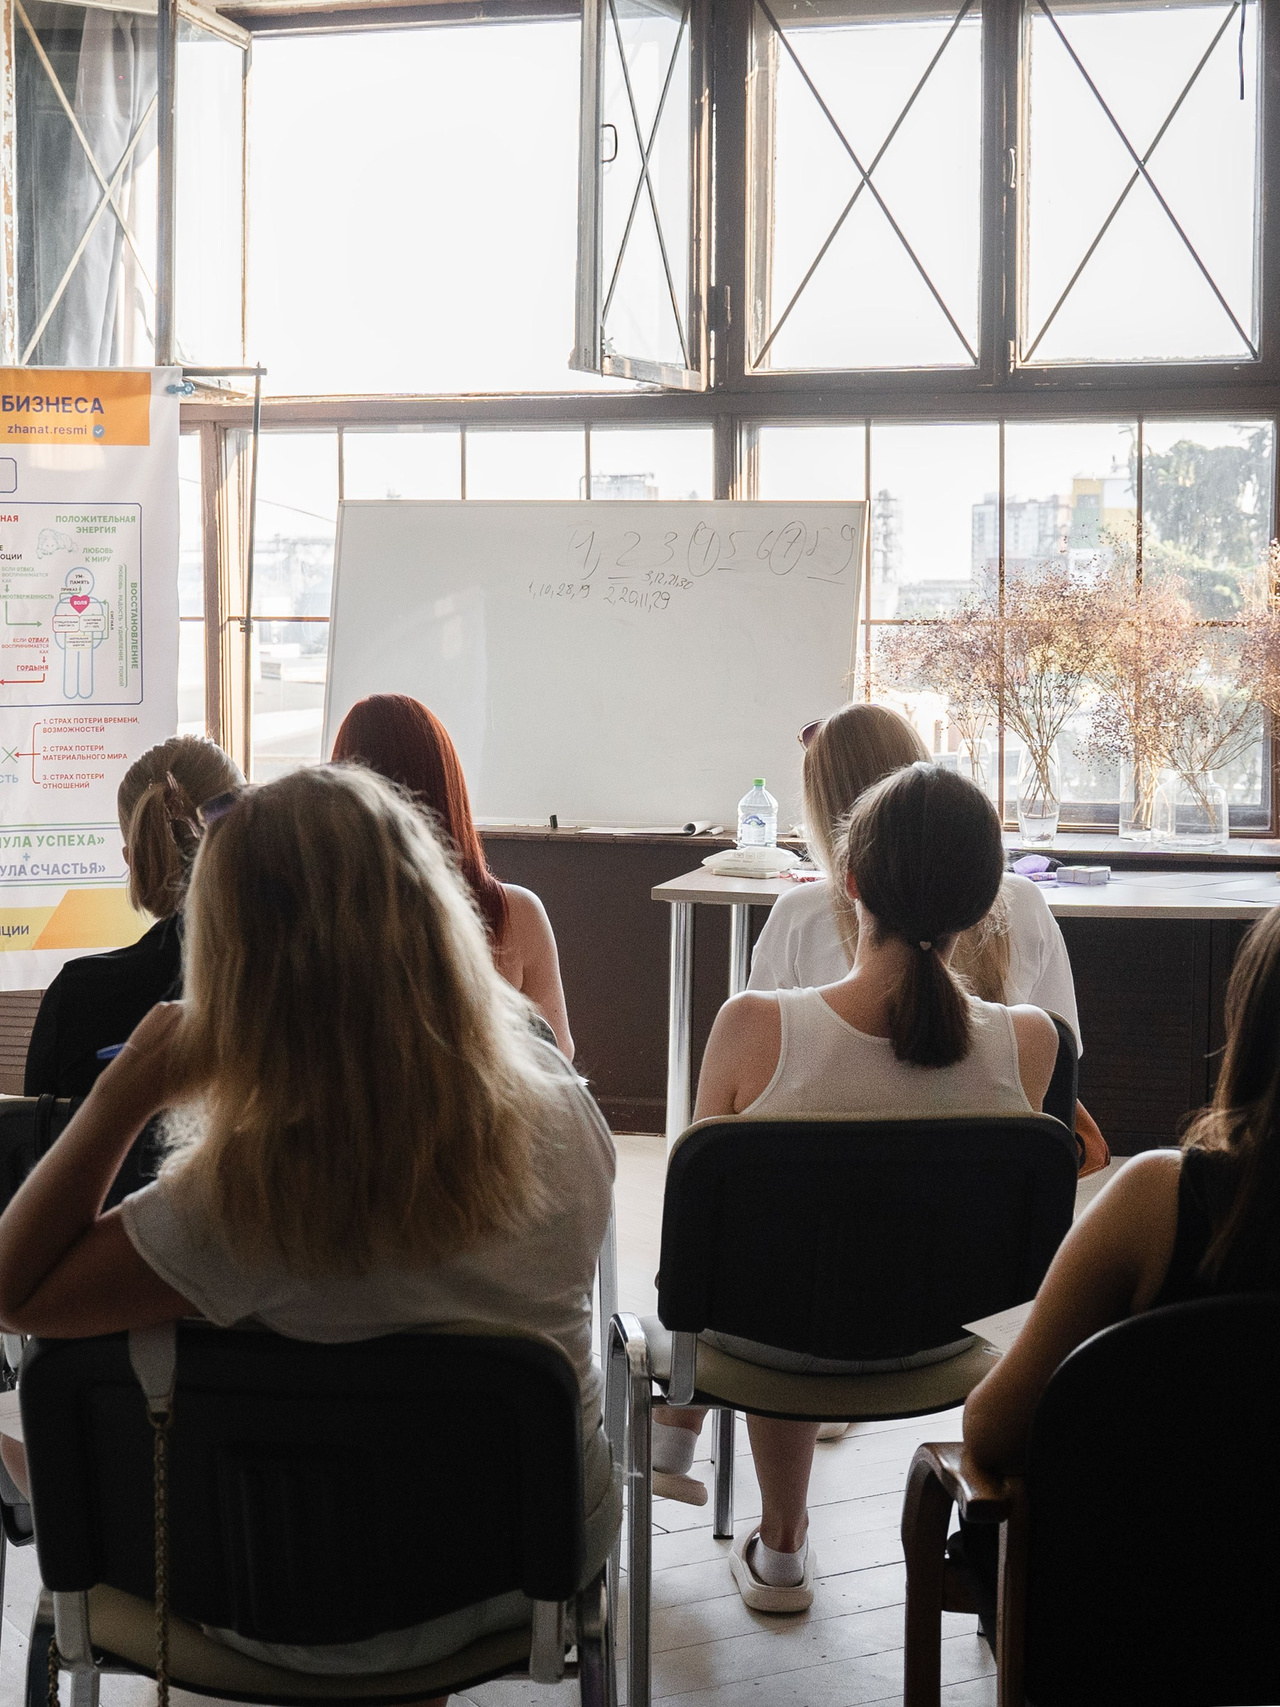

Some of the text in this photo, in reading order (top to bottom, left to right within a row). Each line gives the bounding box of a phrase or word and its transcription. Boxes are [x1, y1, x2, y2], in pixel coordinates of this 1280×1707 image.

[2, 394, 105, 414] БИЗНЕСА
[7, 423, 88, 436] zhanat.resmi
[55, 515, 136, 524] ПОЛОЖИТЕЛЬНАЯ
[75, 526, 117, 534] ЭНЕРГИЯ
[130, 582, 139, 669] ВОССТАНОВЛЕНИЕ
[42, 725, 105, 733] ВОЗМОЖНОСТЕЙ
[42, 781, 90, 789] ОТНОШЕНИЙ
[37, 834, 106, 848] УСПЕХА»
[33, 862, 106, 876] СЧАСТЬЯ»
